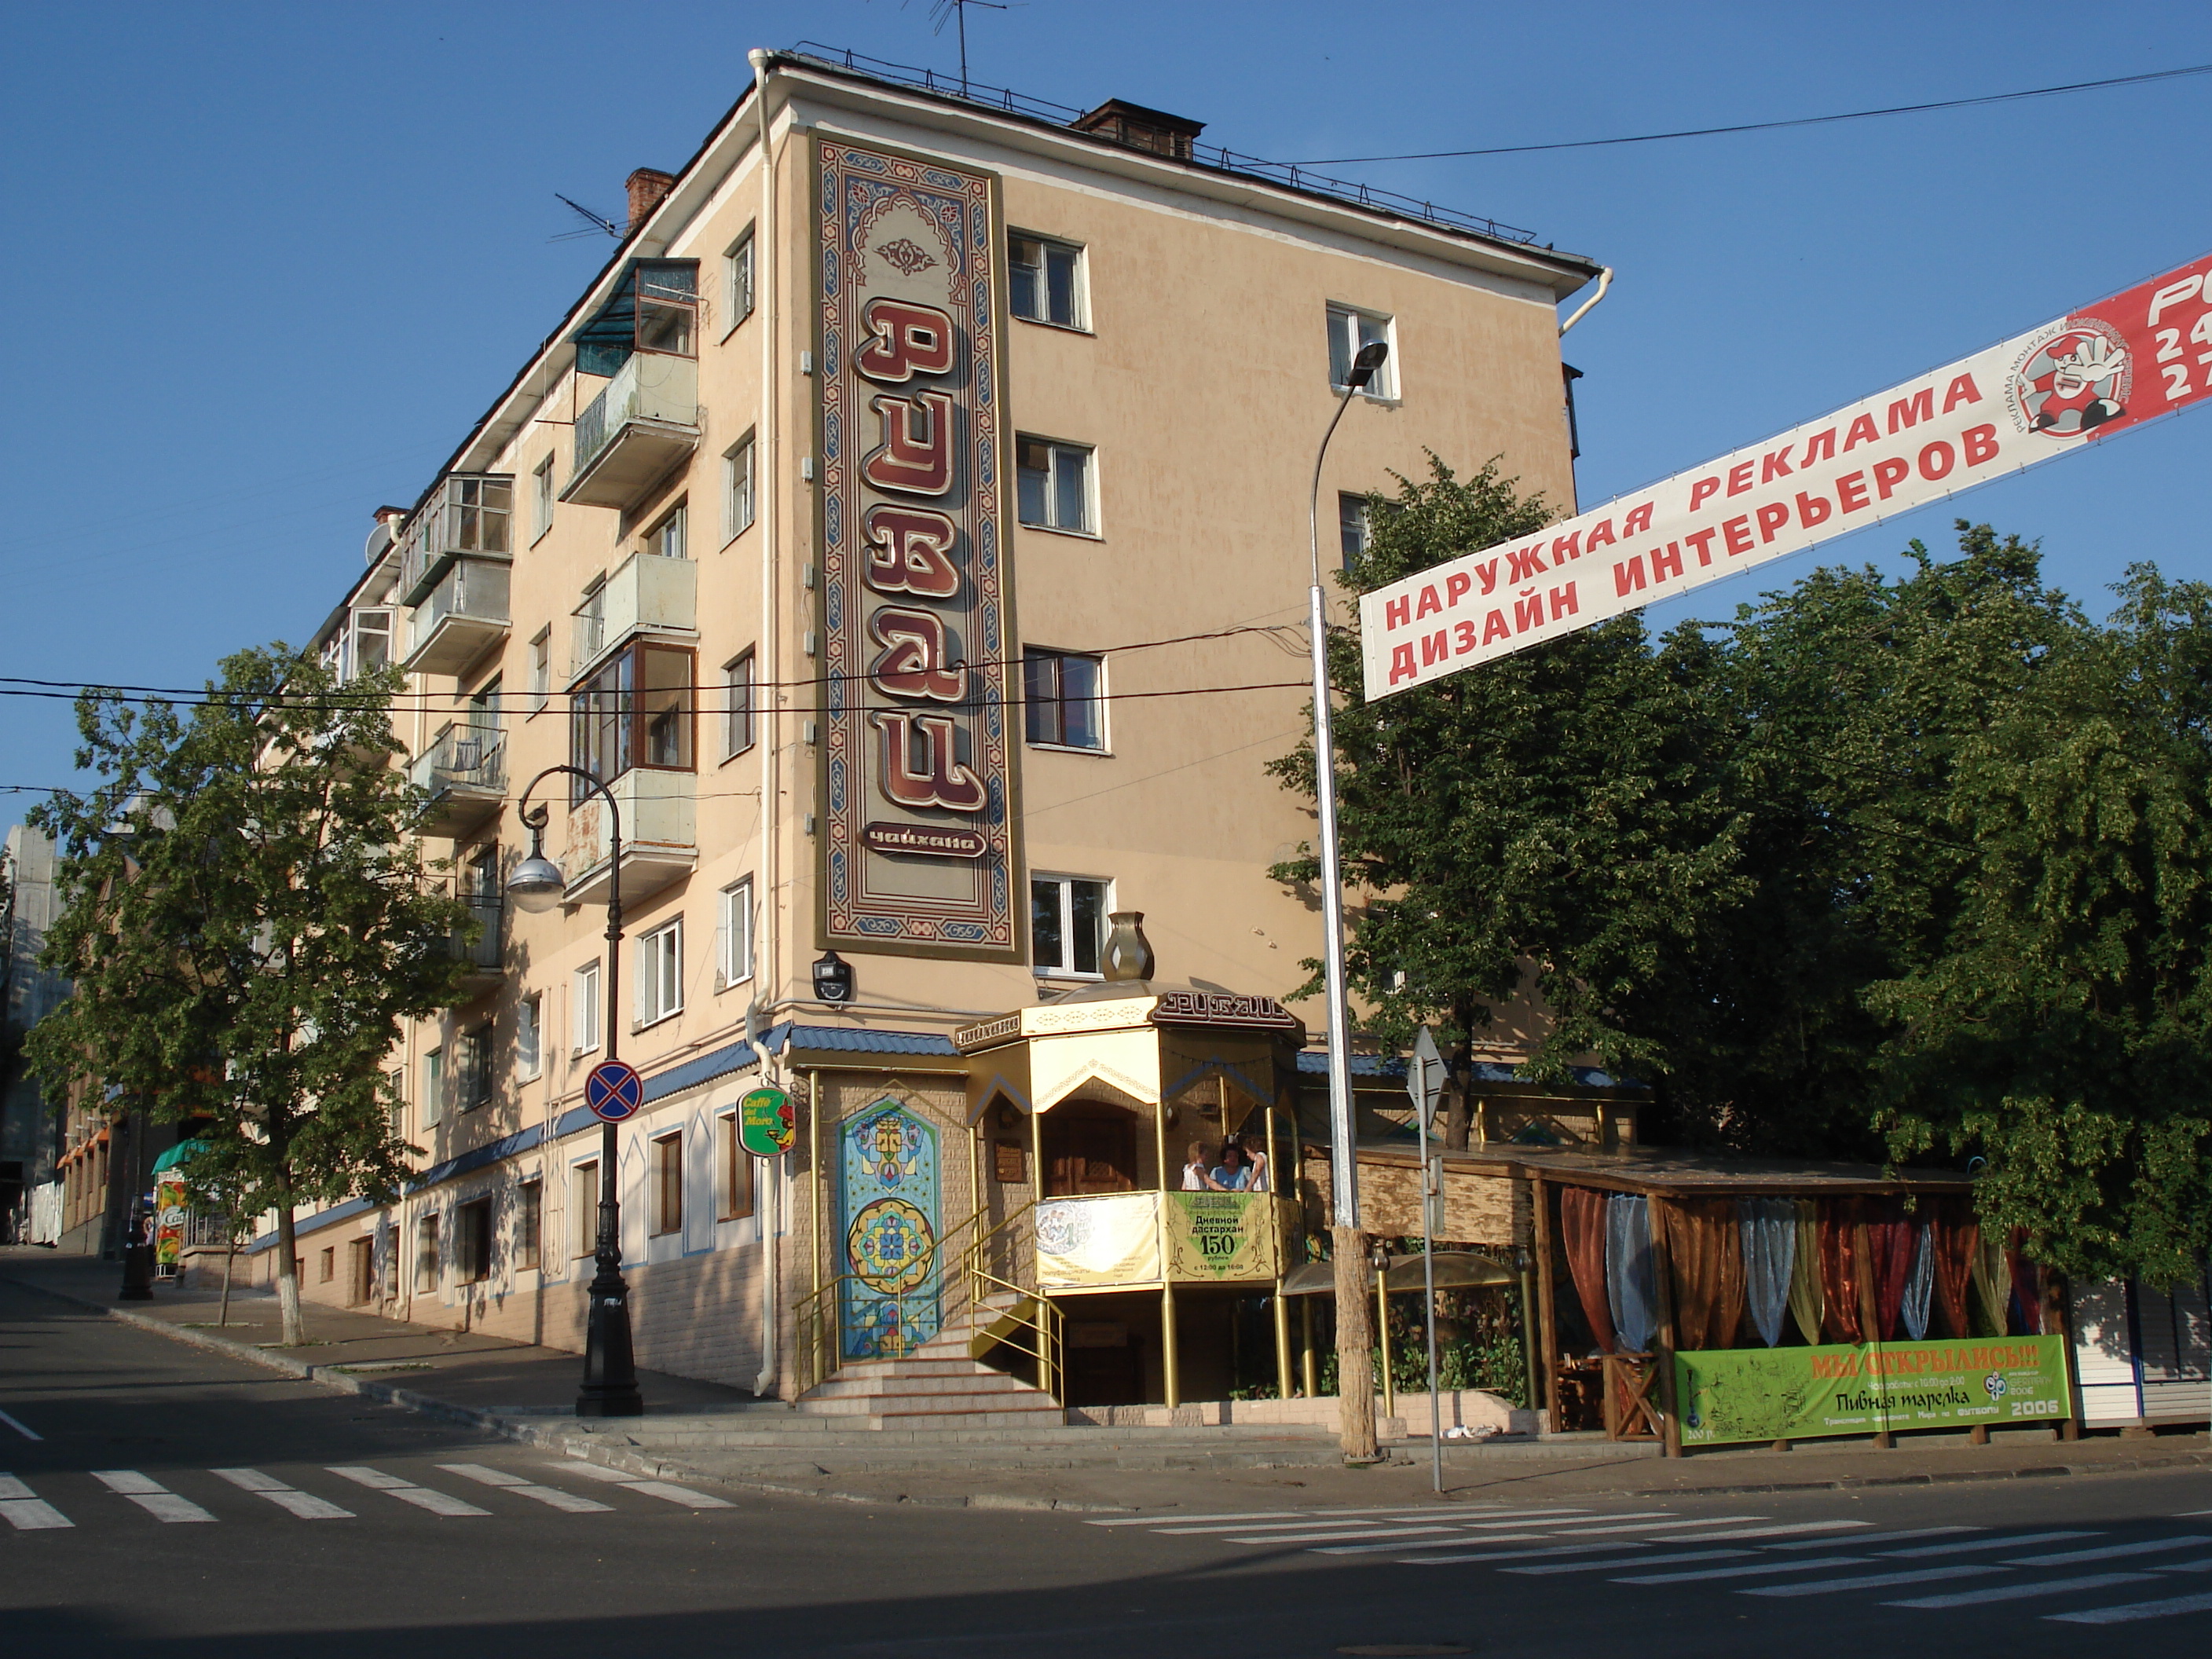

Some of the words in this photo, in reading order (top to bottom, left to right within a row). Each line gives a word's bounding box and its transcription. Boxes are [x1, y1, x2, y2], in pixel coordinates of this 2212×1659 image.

[2010, 327, 2056, 372] МОНТАЖ
[2005, 374, 2027, 434] РЕКЛАМА
[1386, 502, 1654, 631] НАРУЖНАЯ
[1689, 373, 1983, 512] РЕКЛАМА
[1389, 581, 1580, 686] ДИЗАЙН
[1613, 423, 2000, 598] ИНТЕРЬЕРОВ
[745, 1116, 773, 1126] Moro
[1192, 1226, 1243, 1235] дастархан
[1196, 1215, 1239, 1225] Дневной
[1200, 1234, 1235, 1255] 150
[1810, 1353, 1859, 1379] МЫ
[1864, 1344, 2040, 1375] ОТКРЫЛИСЬ!!!
[1835, 1390, 1896, 1412] Пивная
[1900, 1385, 1971, 1412] тарелка
[2010, 1386, 2034, 1396] 2006
[2010, 1399, 2059, 1417] 2006
[1687, 1430, 1704, 1440] 200
